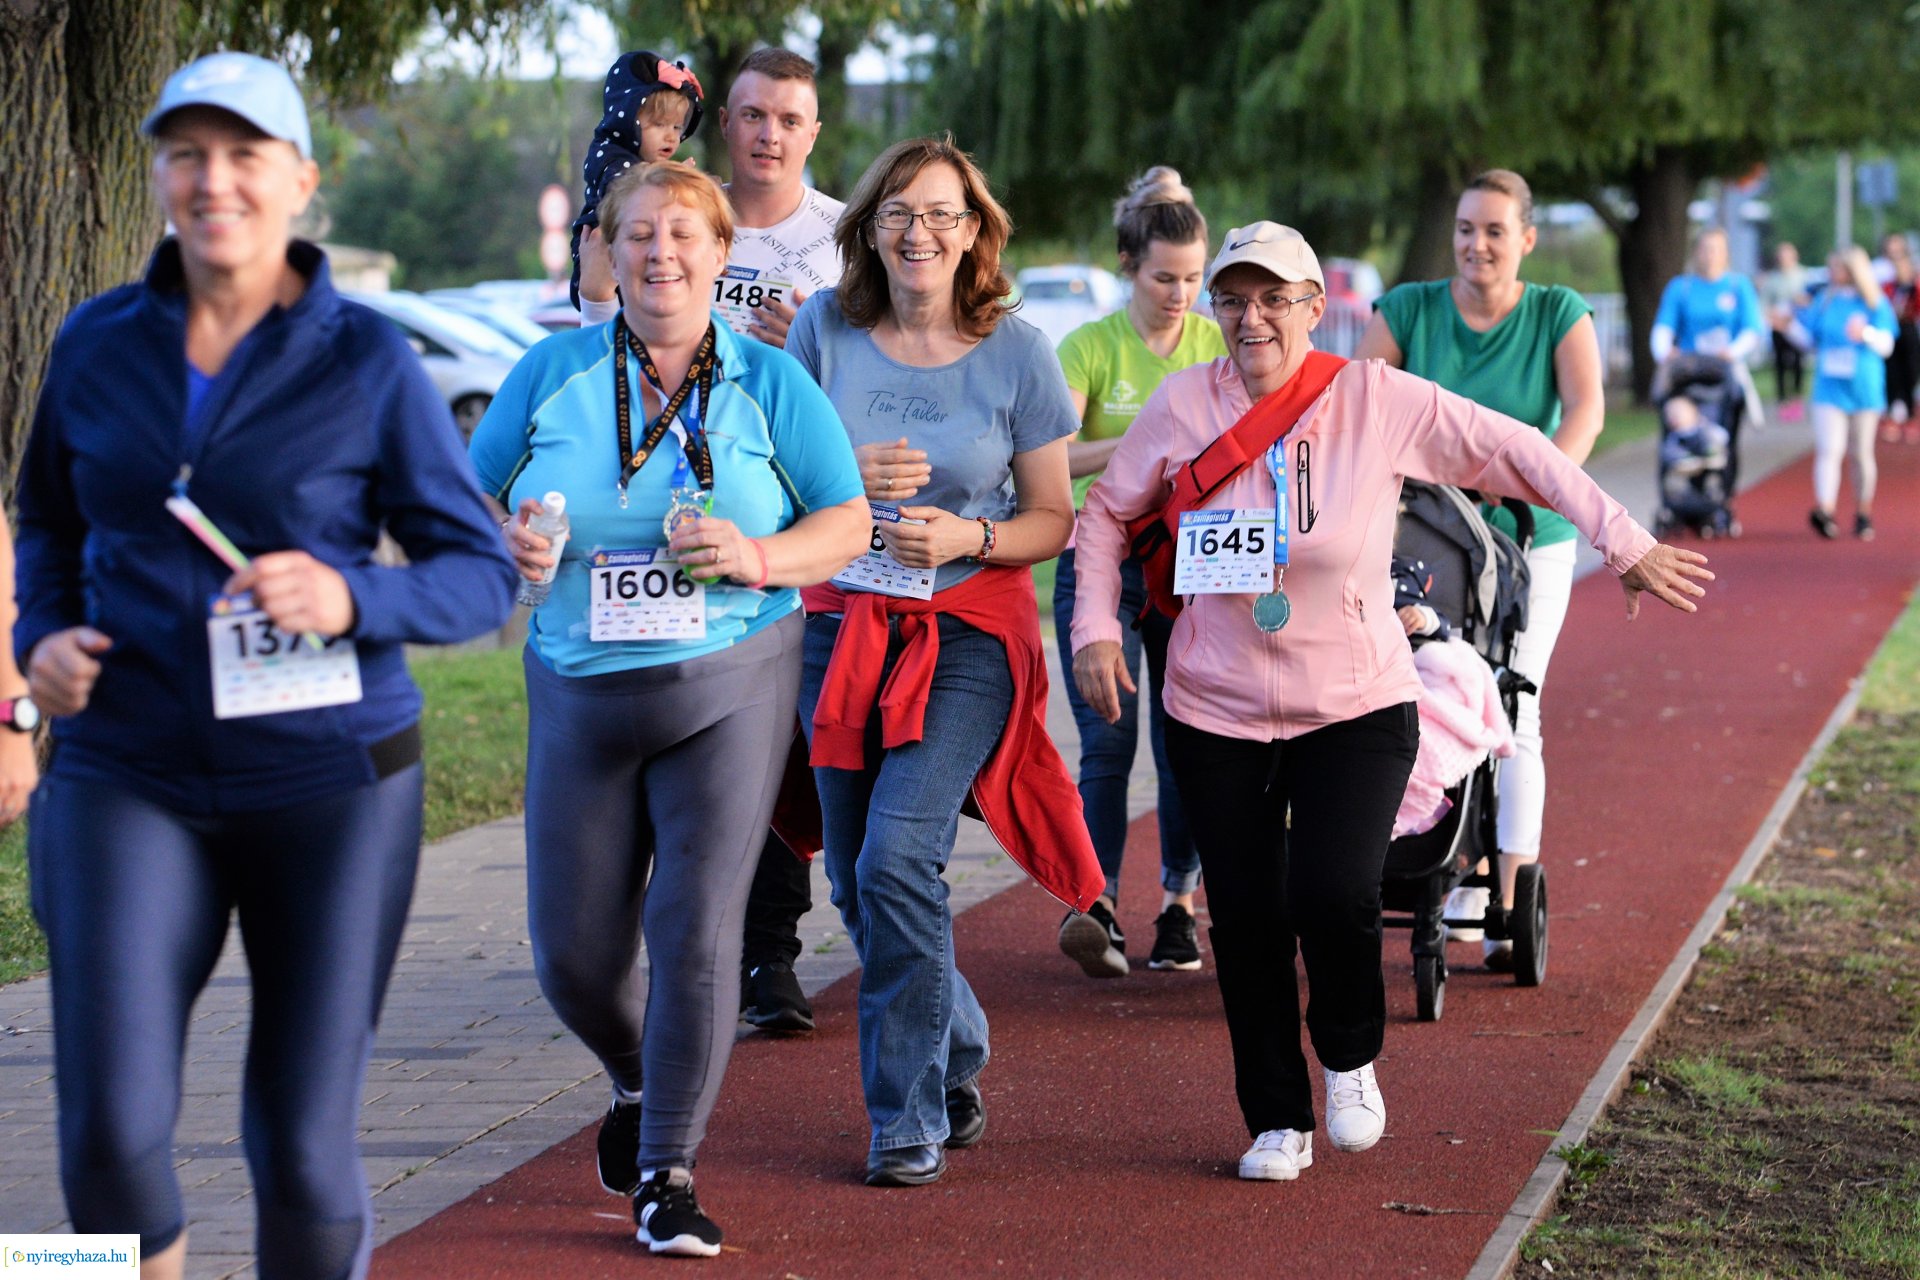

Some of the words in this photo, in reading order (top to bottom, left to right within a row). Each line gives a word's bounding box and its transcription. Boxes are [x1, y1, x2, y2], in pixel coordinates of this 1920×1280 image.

[714, 280, 783, 311] 1485
[867, 390, 896, 417] Tom
[646, 426, 664, 447] AIKA
[1186, 527, 1266, 557] 1645
[600, 568, 696, 600] 1606
